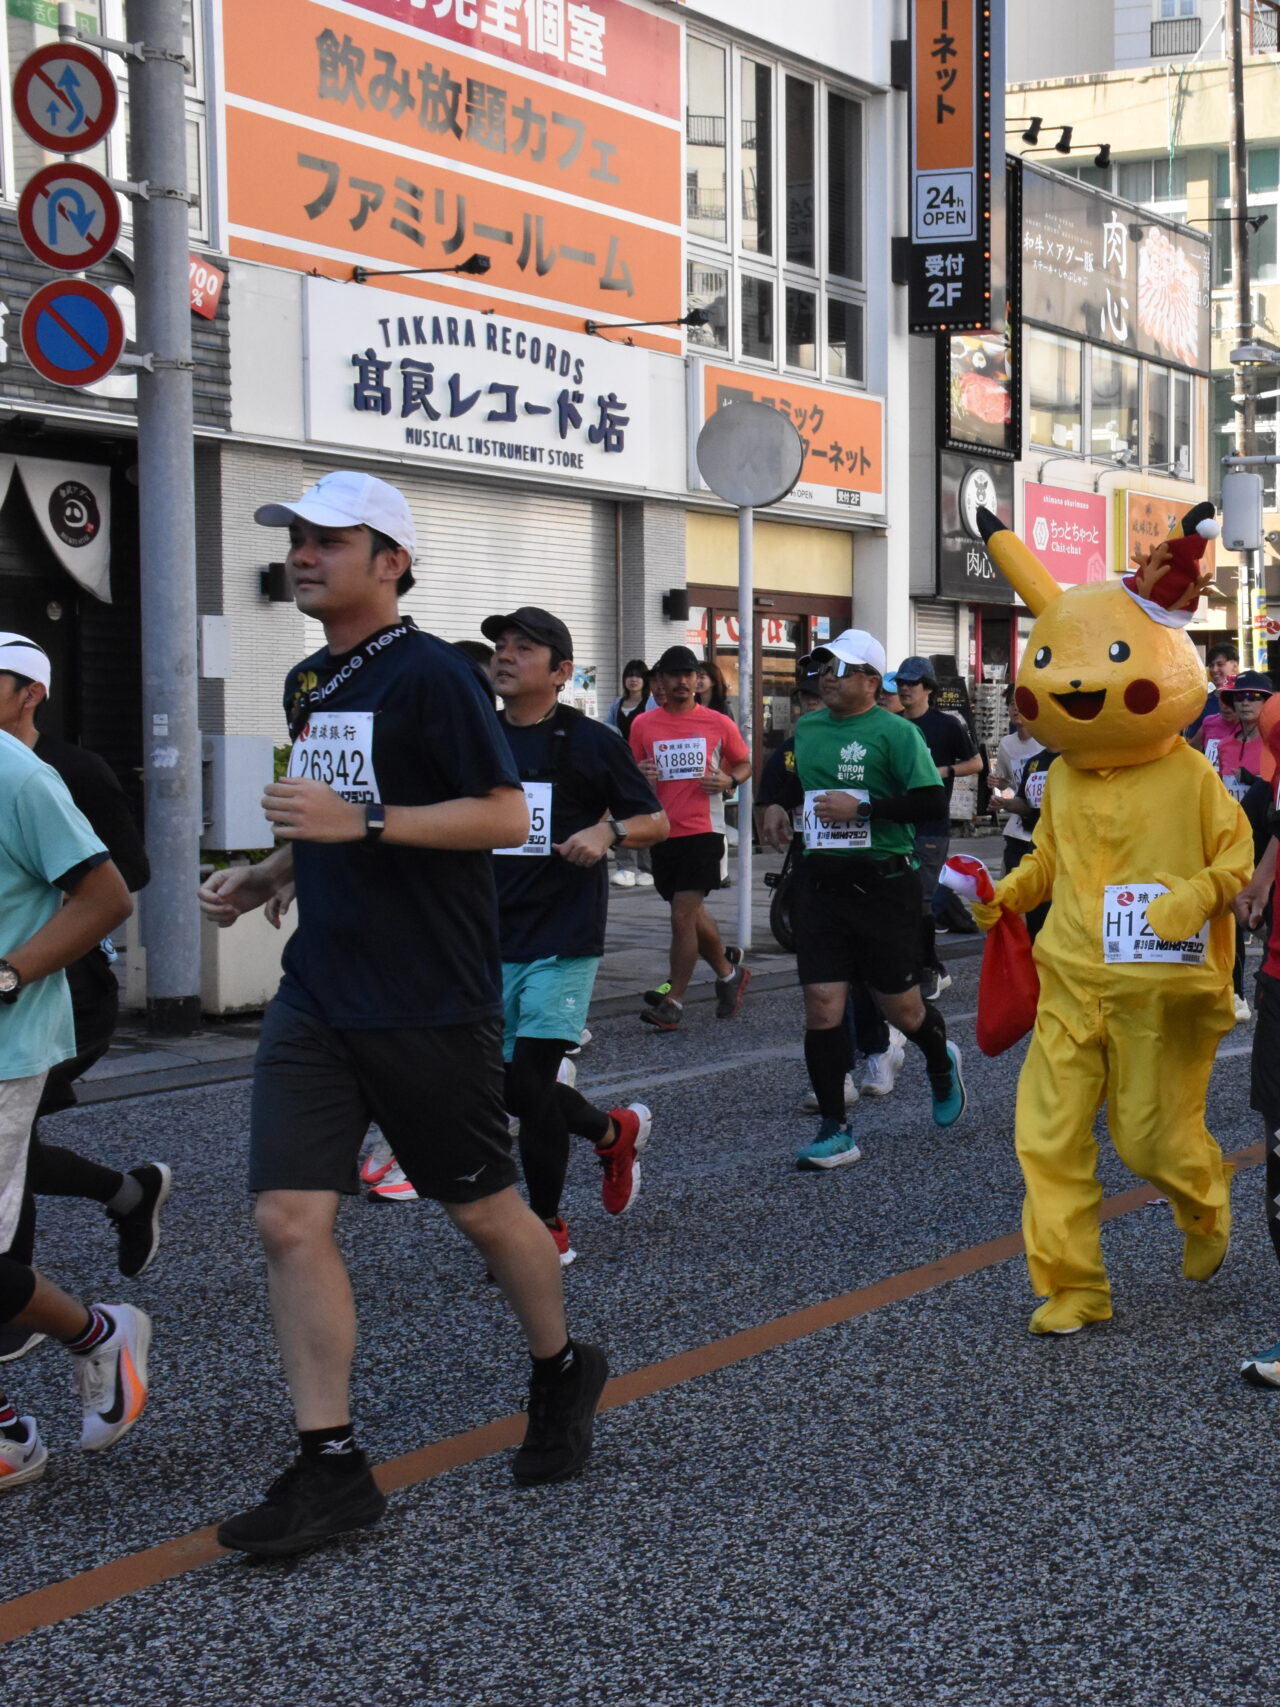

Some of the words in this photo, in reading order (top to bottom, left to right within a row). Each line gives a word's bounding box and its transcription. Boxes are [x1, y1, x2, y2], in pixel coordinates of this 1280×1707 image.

[394, 0, 607, 77] 全個室
[315, 27, 621, 186] 飲み放題カフェ
[926, 186, 964, 211] 24h
[297, 151, 635, 298] ファミリールーム
[923, 211, 966, 226] OPEN
[924, 254, 965, 278] 受付
[1100, 210, 1129, 342] 肉心
[928, 282, 962, 308] 2F
[378, 315, 476, 348] TAKARA
[486, 322, 585, 385] RECORDS
[405, 427, 463, 452] MUSICAL
[467, 436, 545, 464] INSTRUMENT
[548, 449, 584, 469] STORE
[1050, 519, 1099, 544] ちっとちゃっと
[966, 547, 993, 579] 肉心
[366, 626, 408, 656] new
[310, 724, 357, 742] 琉球銀行
[300, 748, 369, 787] 26342
[656, 751, 704, 768] K18889
[838, 764, 865, 773] YORON
[837, 773, 865, 781] モリンガ
